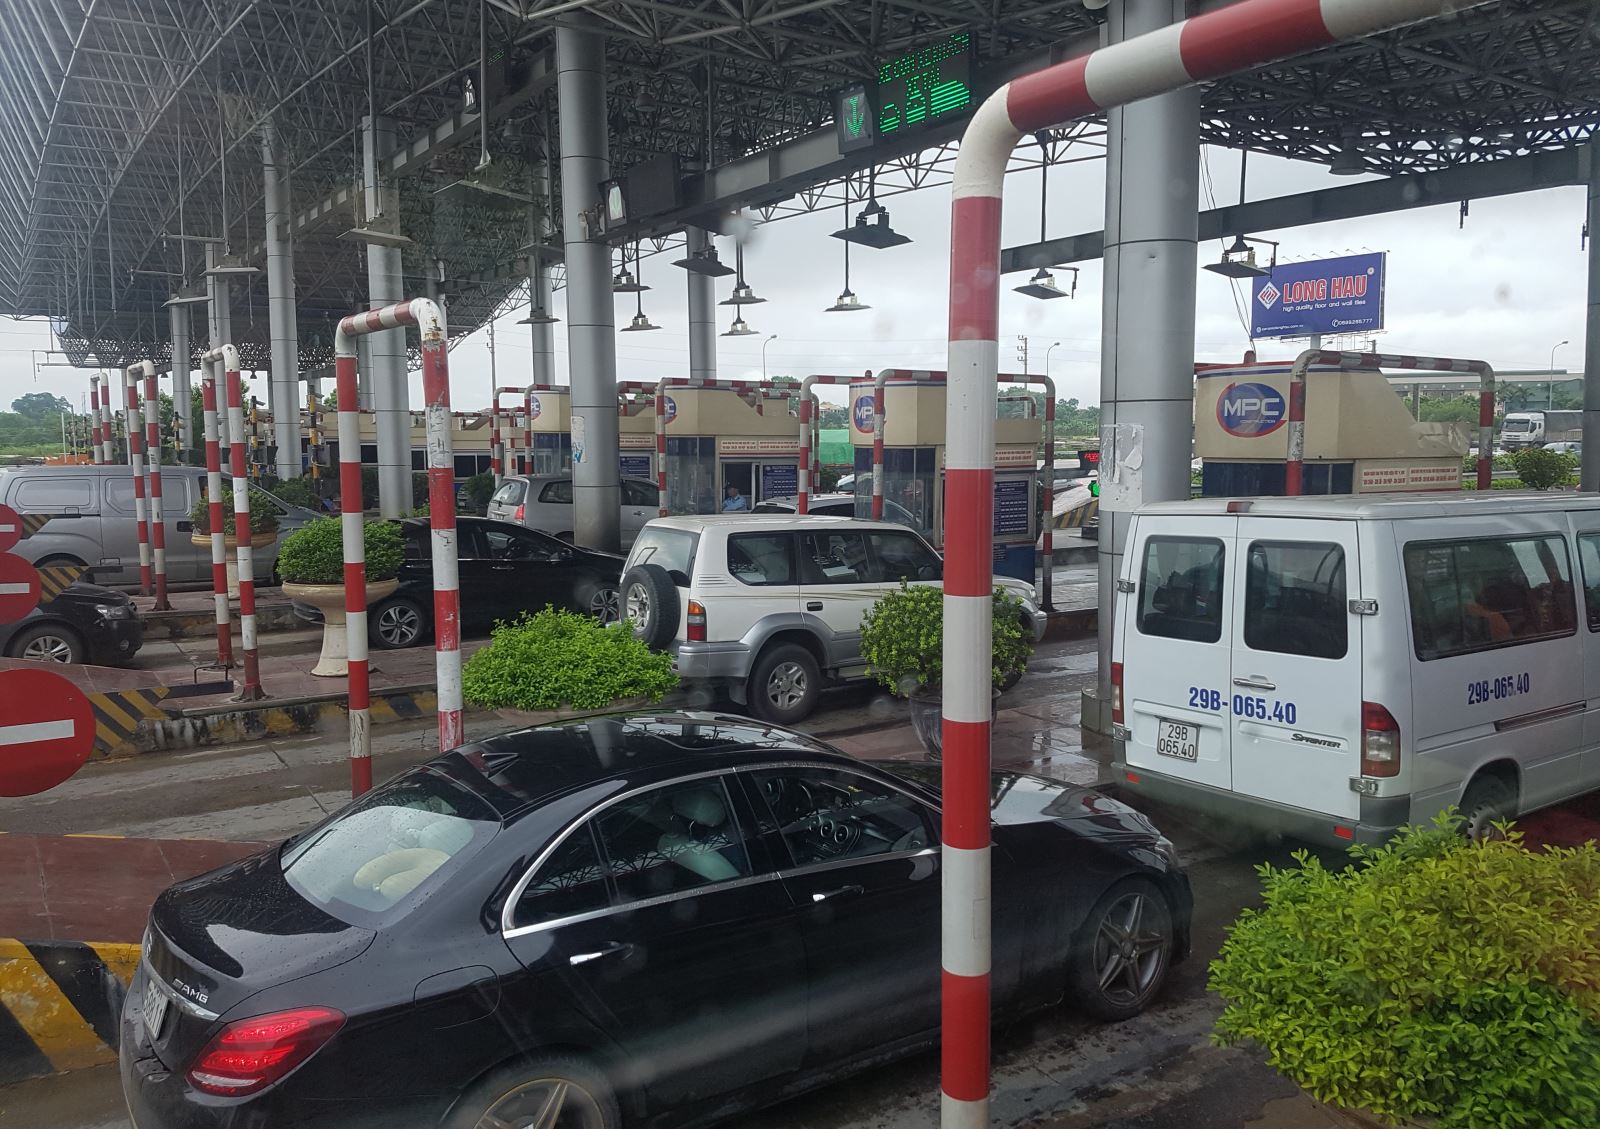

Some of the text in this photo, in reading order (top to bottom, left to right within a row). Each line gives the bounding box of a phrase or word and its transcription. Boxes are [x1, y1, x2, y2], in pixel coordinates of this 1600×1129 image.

[1283, 274, 1367, 304] LONG HAU
[1282, 305, 1294, 313] high
[856, 406, 875, 420] MP
[1224, 397, 1280, 417] MPC
[1467, 672, 1531, 705] 29B-065.40
[1167, 724, 1188, 741] 29B
[1159, 738, 1195, 758] 065.40
[181, 984, 209, 1004] AMG
